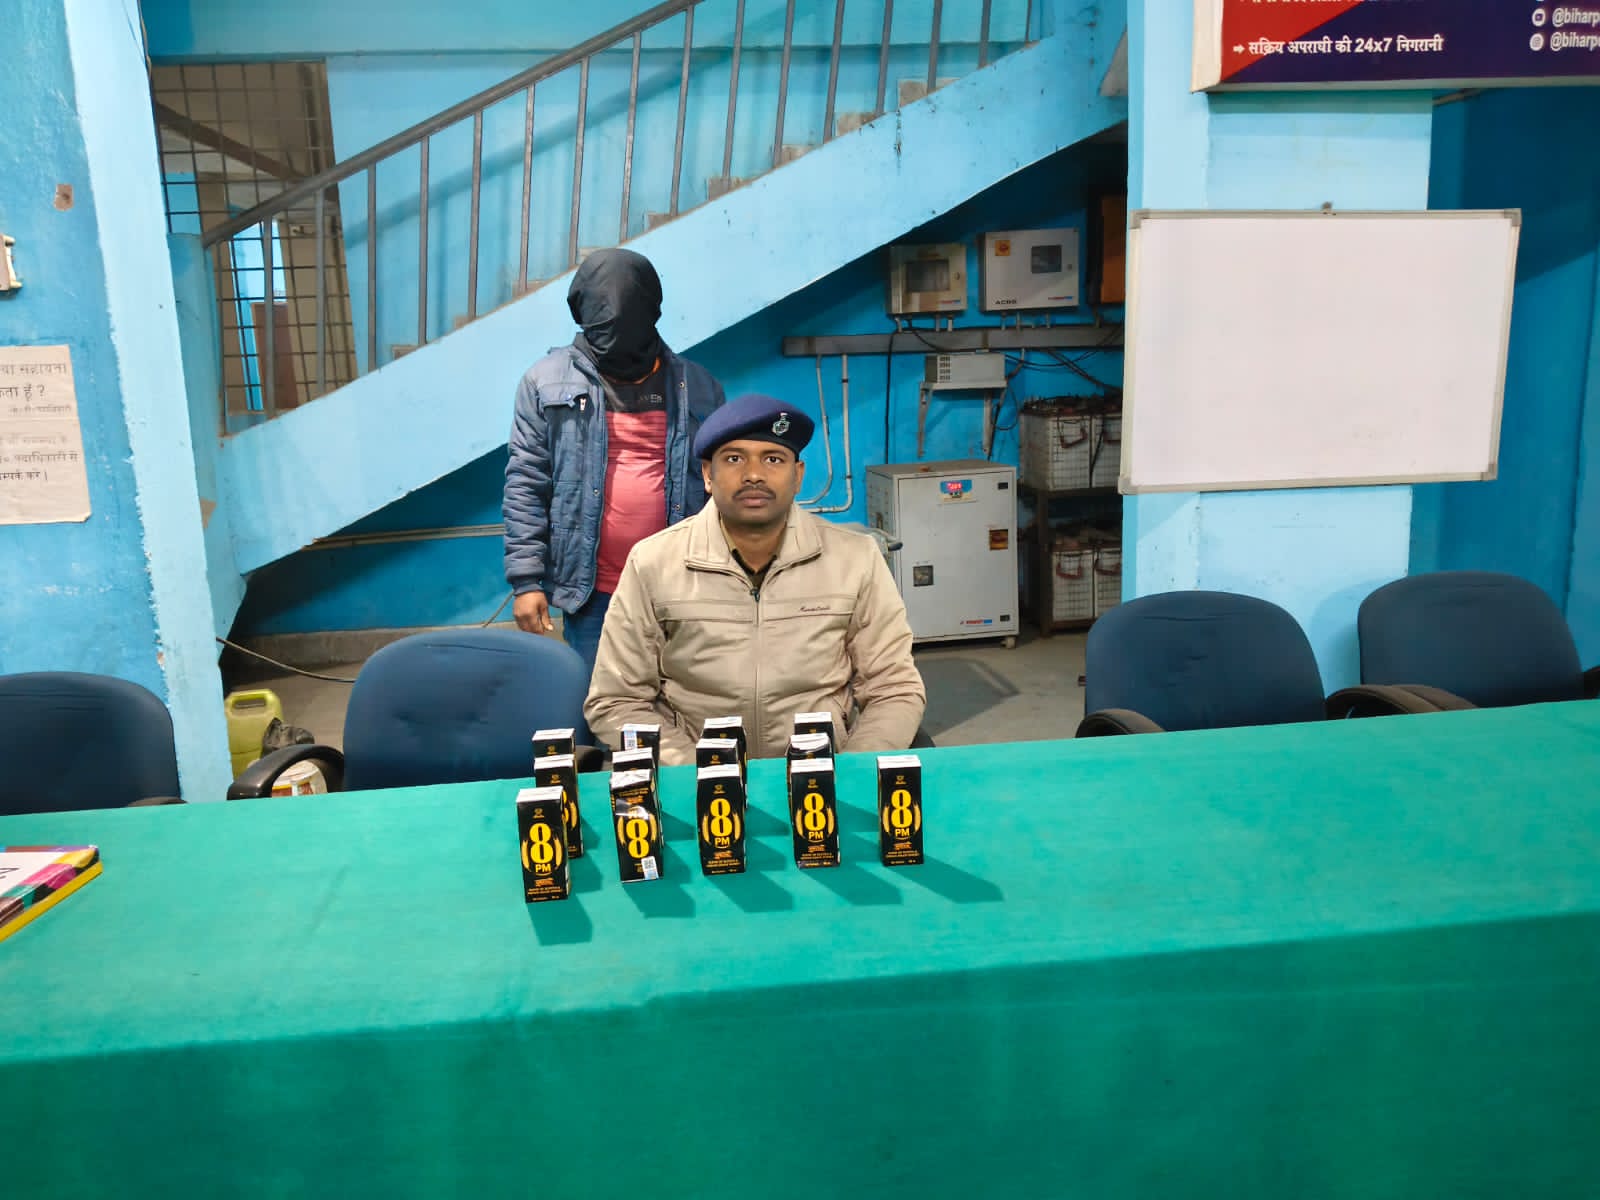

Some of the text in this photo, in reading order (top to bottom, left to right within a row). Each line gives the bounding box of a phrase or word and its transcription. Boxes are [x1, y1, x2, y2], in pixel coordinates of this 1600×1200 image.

[1248, 37, 1286, 56] सक्रिय
[1335, 34, 1352, 54] की
[1354, 37, 1392, 53] 24x7
[1396, 33, 1444, 53] निगरानी
[710, 798, 733, 837] 8
[804, 792, 826, 831] 8
[891, 789, 912, 828] 8
[529, 822, 554, 863] 8
[626, 819, 649, 859] 8
[714, 837, 730, 846] PM
[808, 831, 823, 840] PM
[895, 828, 910, 837] PM
[535, 863, 551, 873] PM
